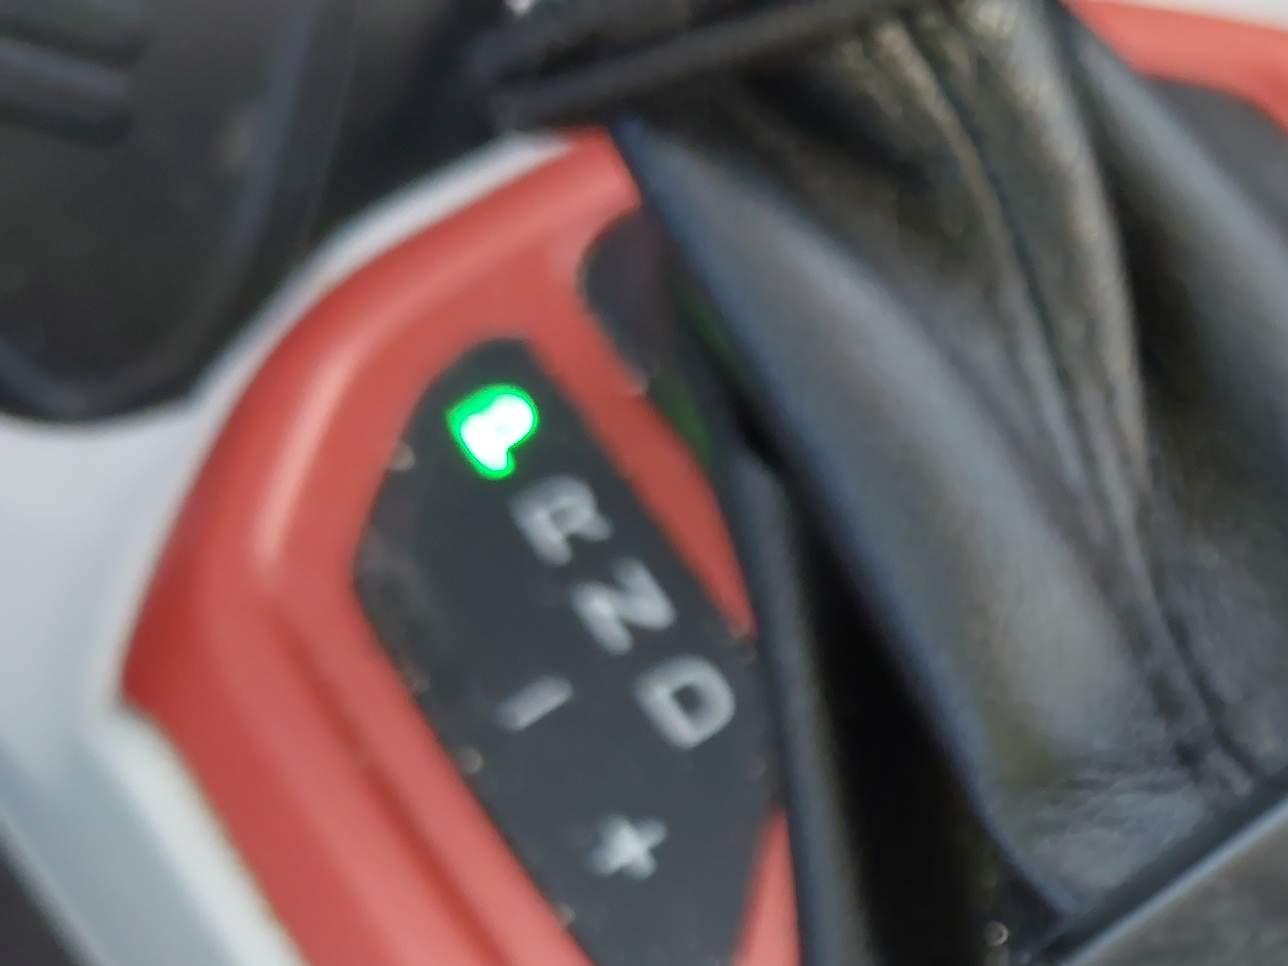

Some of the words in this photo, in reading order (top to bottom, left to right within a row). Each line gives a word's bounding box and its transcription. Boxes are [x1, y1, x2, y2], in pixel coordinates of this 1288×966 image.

[447, 385, 538, 479] P
[511, 474, 611, 564] R
[573, 558, 675, 654] N
[636, 655, 734, 748] D
